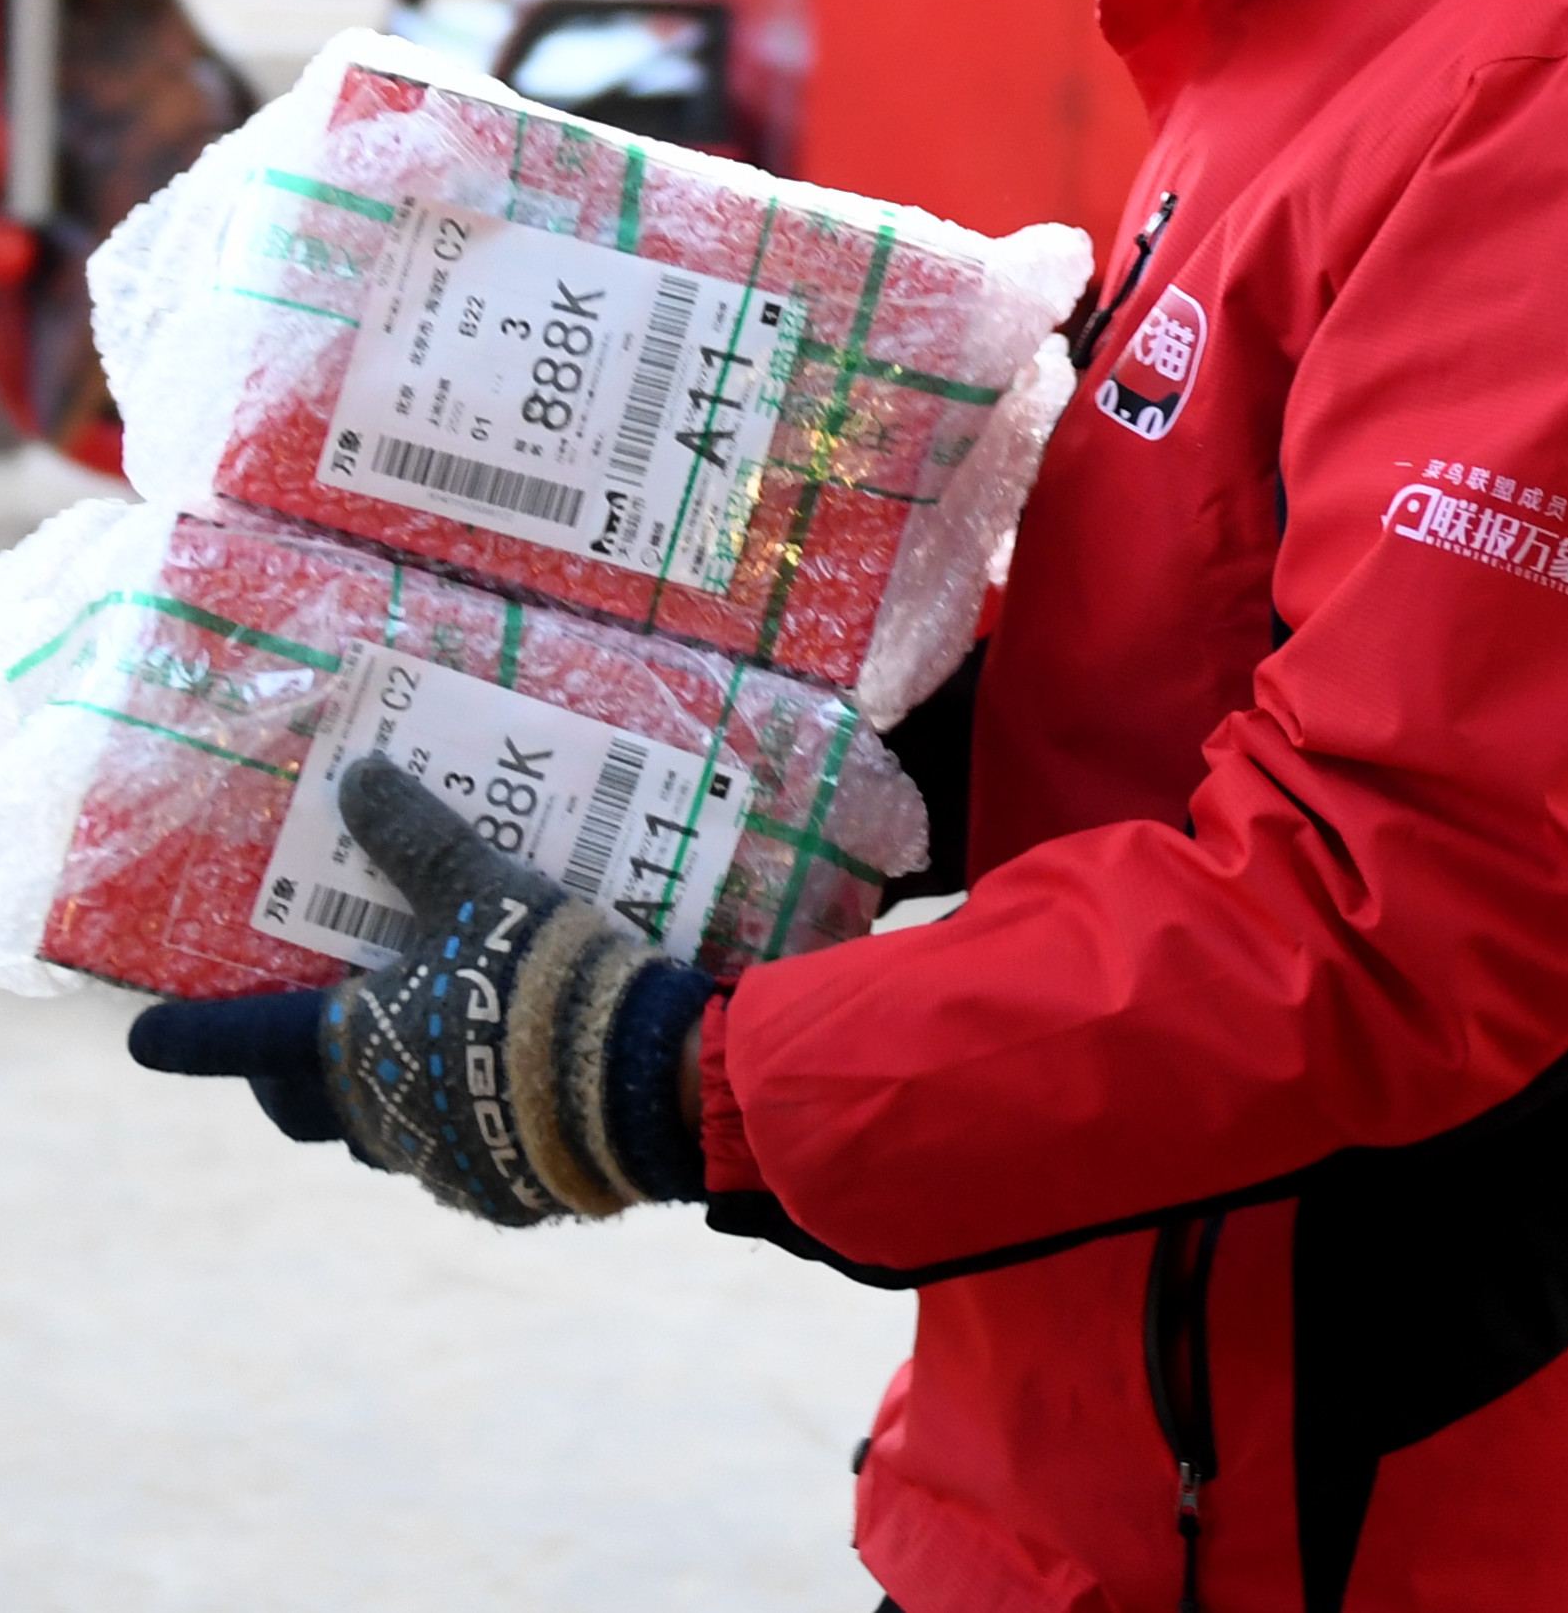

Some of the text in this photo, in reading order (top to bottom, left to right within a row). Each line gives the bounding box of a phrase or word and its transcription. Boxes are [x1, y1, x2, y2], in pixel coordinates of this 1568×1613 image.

[429, 213, 473, 265] C2
[456, 292, 488, 338] B22
[497, 313, 534, 342] 3
[520, 277, 606, 433] 888K
[468, 413, 493, 443] 01
[674, 344, 753, 471] A11
[327, 425, 365, 477] 万象
[1422, 459, 1568, 521] 菜鸟联盟成员
[376, 662, 422, 714] C2
[403, 745, 431, 783] 22
[441, 769, 478, 796] 3
[473, 734, 554, 855] 88K
[263, 873, 299, 925] 万象
[613, 810, 701, 943] A11
